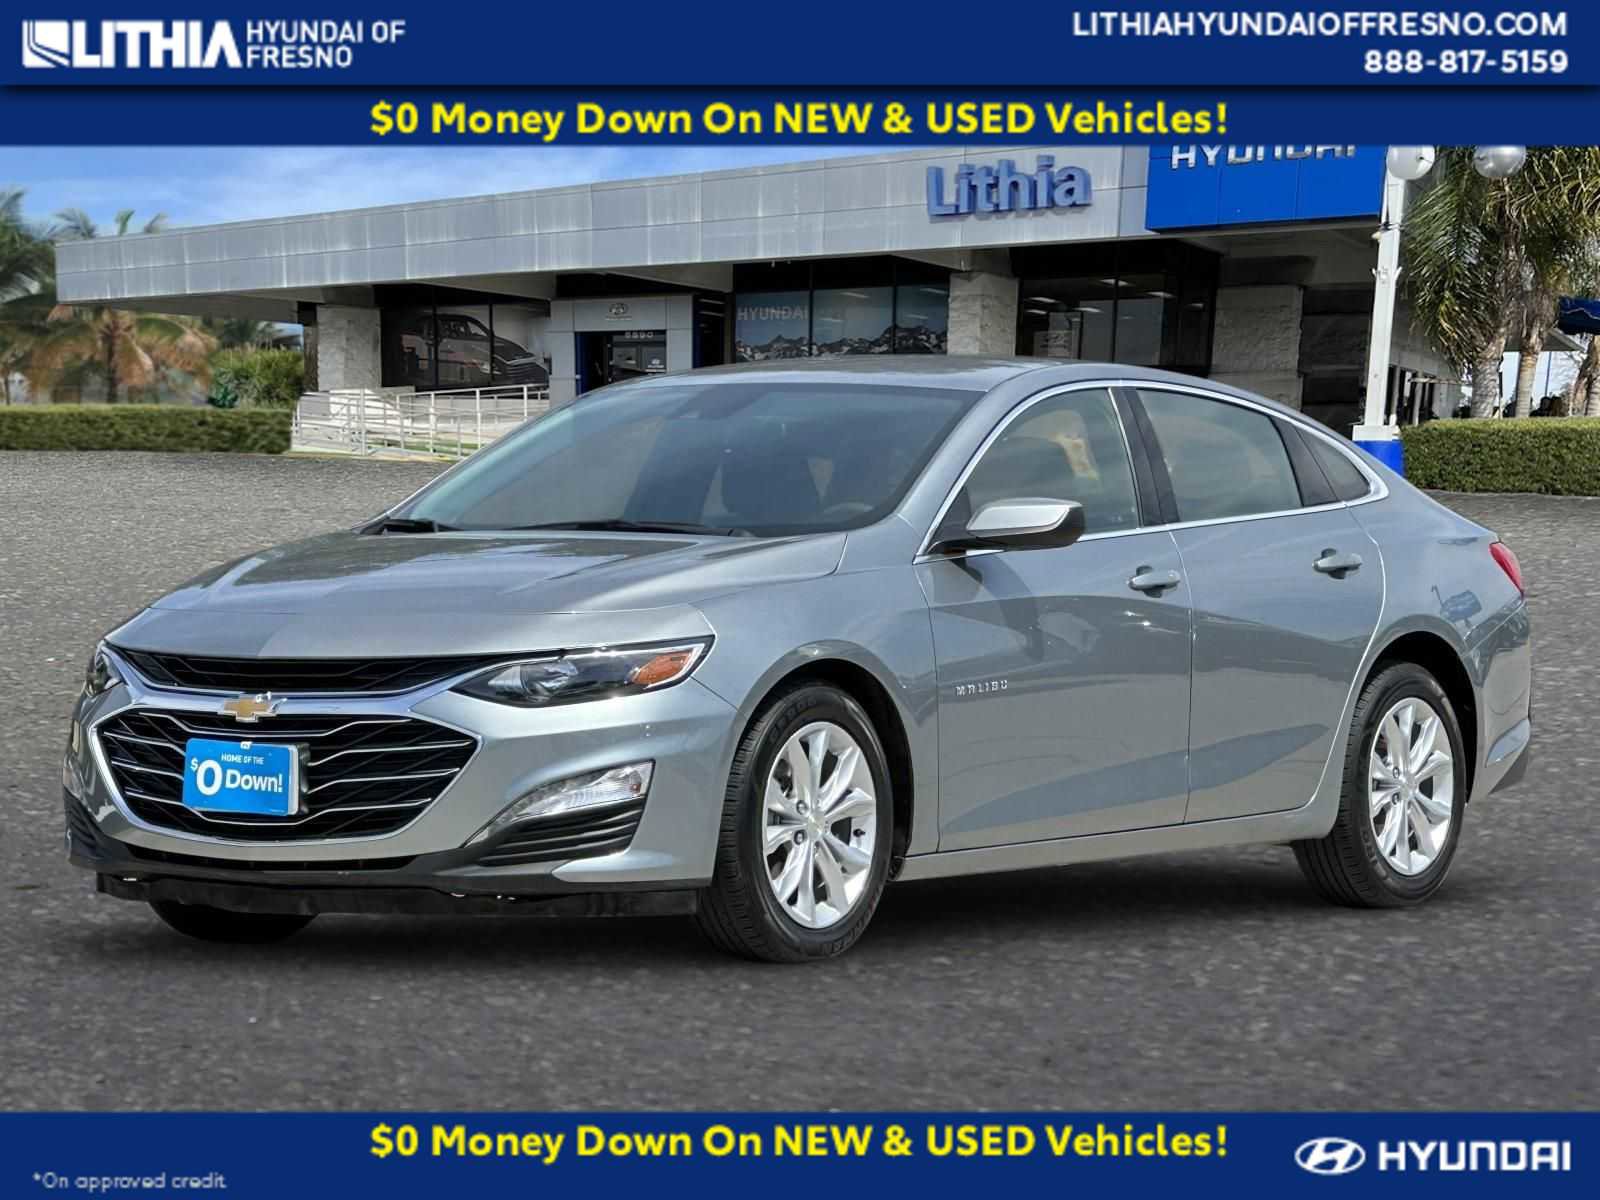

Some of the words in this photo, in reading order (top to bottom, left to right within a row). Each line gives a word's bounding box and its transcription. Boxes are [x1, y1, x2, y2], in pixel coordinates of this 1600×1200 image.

[927, 154, 1093, 217] Lithia
[737, 305, 808, 320] HYUNDAI
[956, 679, 1008, 696] MALIBU
[221, 752, 242, 763] HOME
[225, 769, 283, 793] Down!
